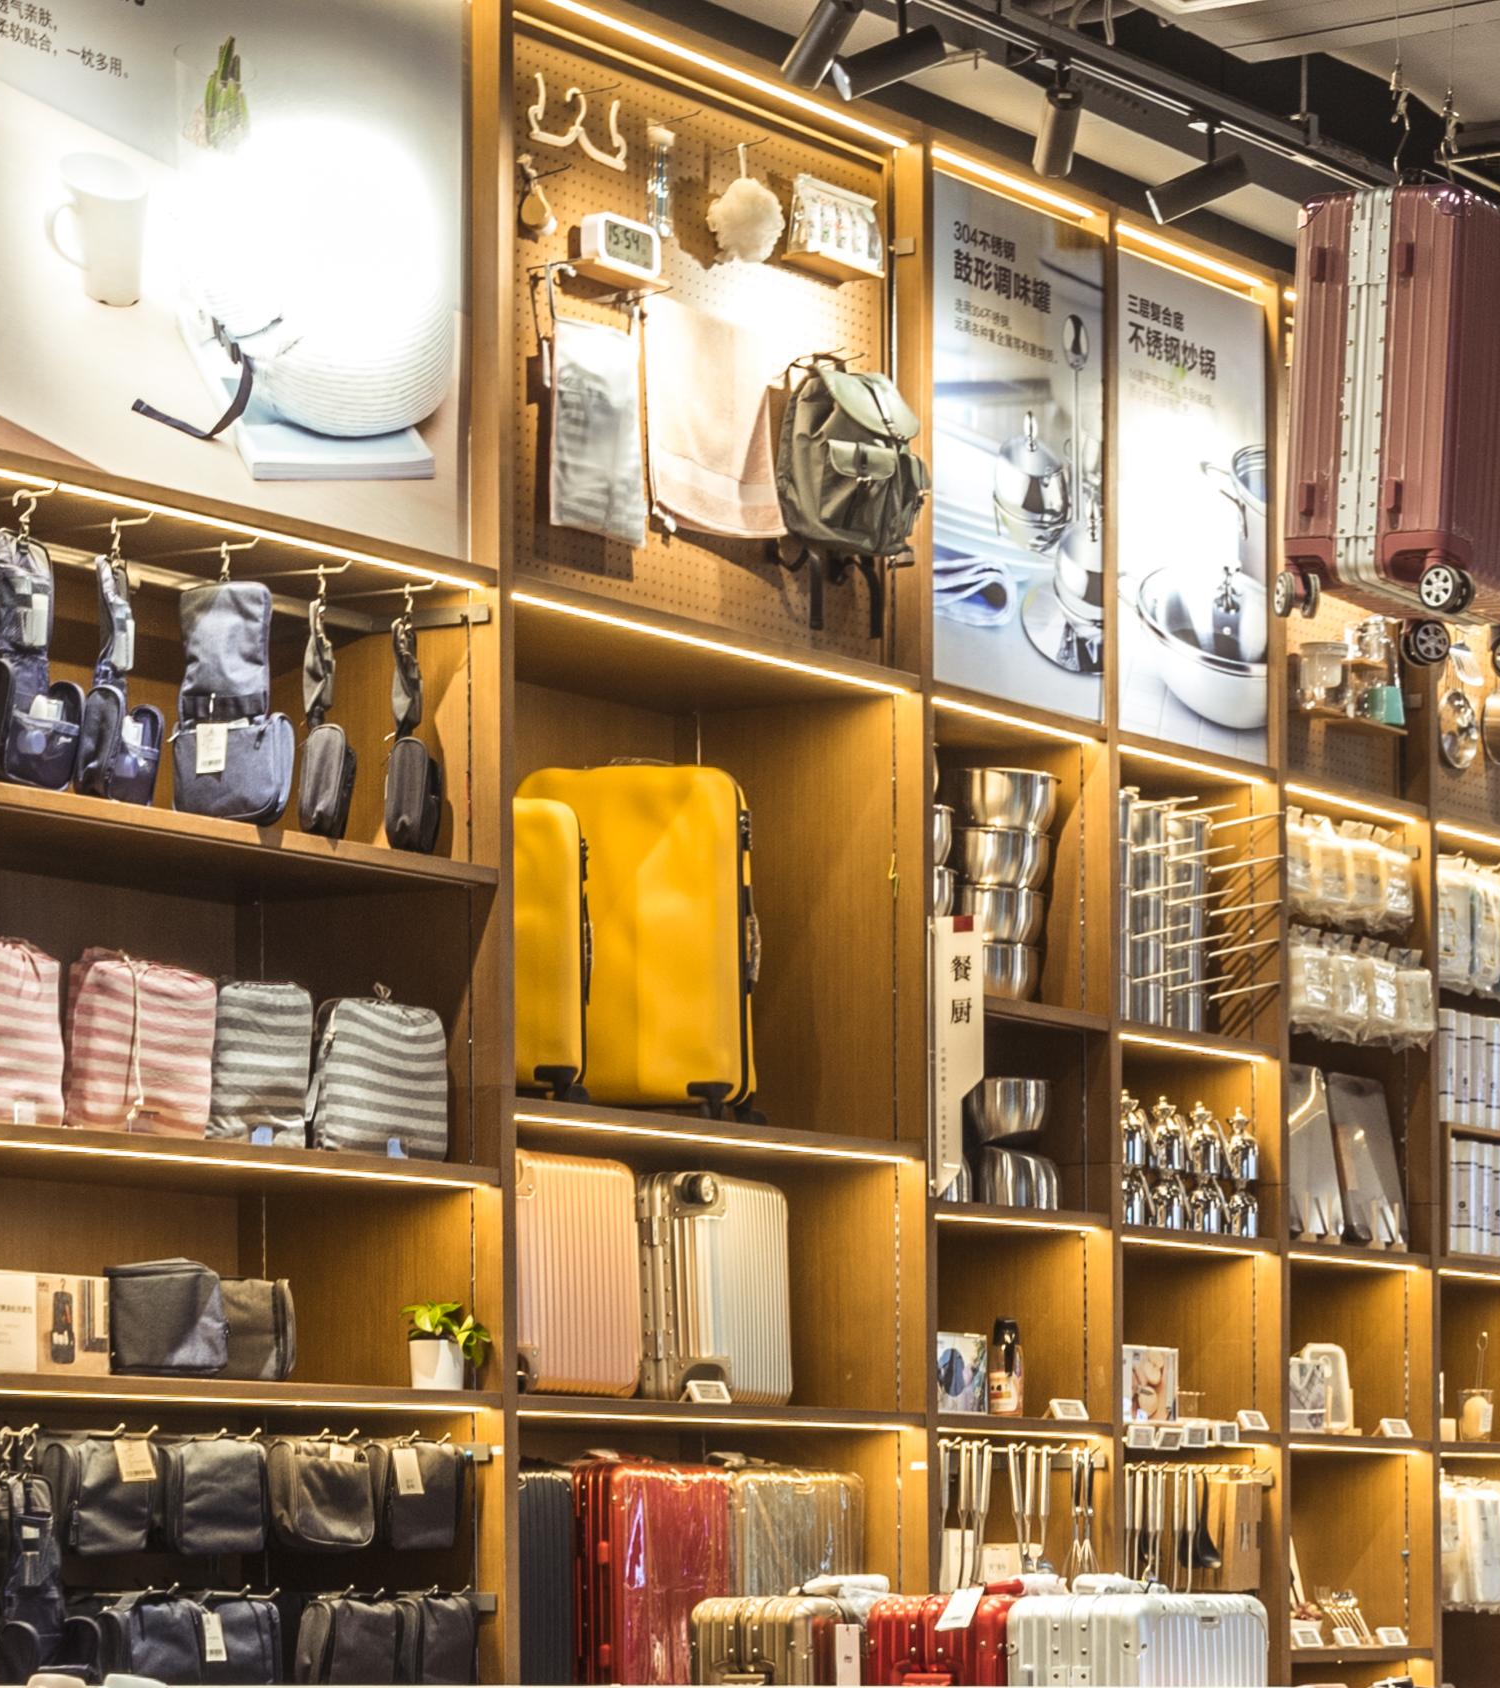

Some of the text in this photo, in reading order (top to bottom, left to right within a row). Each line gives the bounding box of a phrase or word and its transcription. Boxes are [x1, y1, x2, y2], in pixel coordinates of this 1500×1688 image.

[954, 221, 1016, 262] 304不锈钢
[954, 249, 1051, 314] 鼓形调味罐
[1128, 294, 1184, 332] 三层复合底
[1128, 321, 1216, 381] 不锈钢炒锅
[950, 956, 972, 1024] 餐厨
